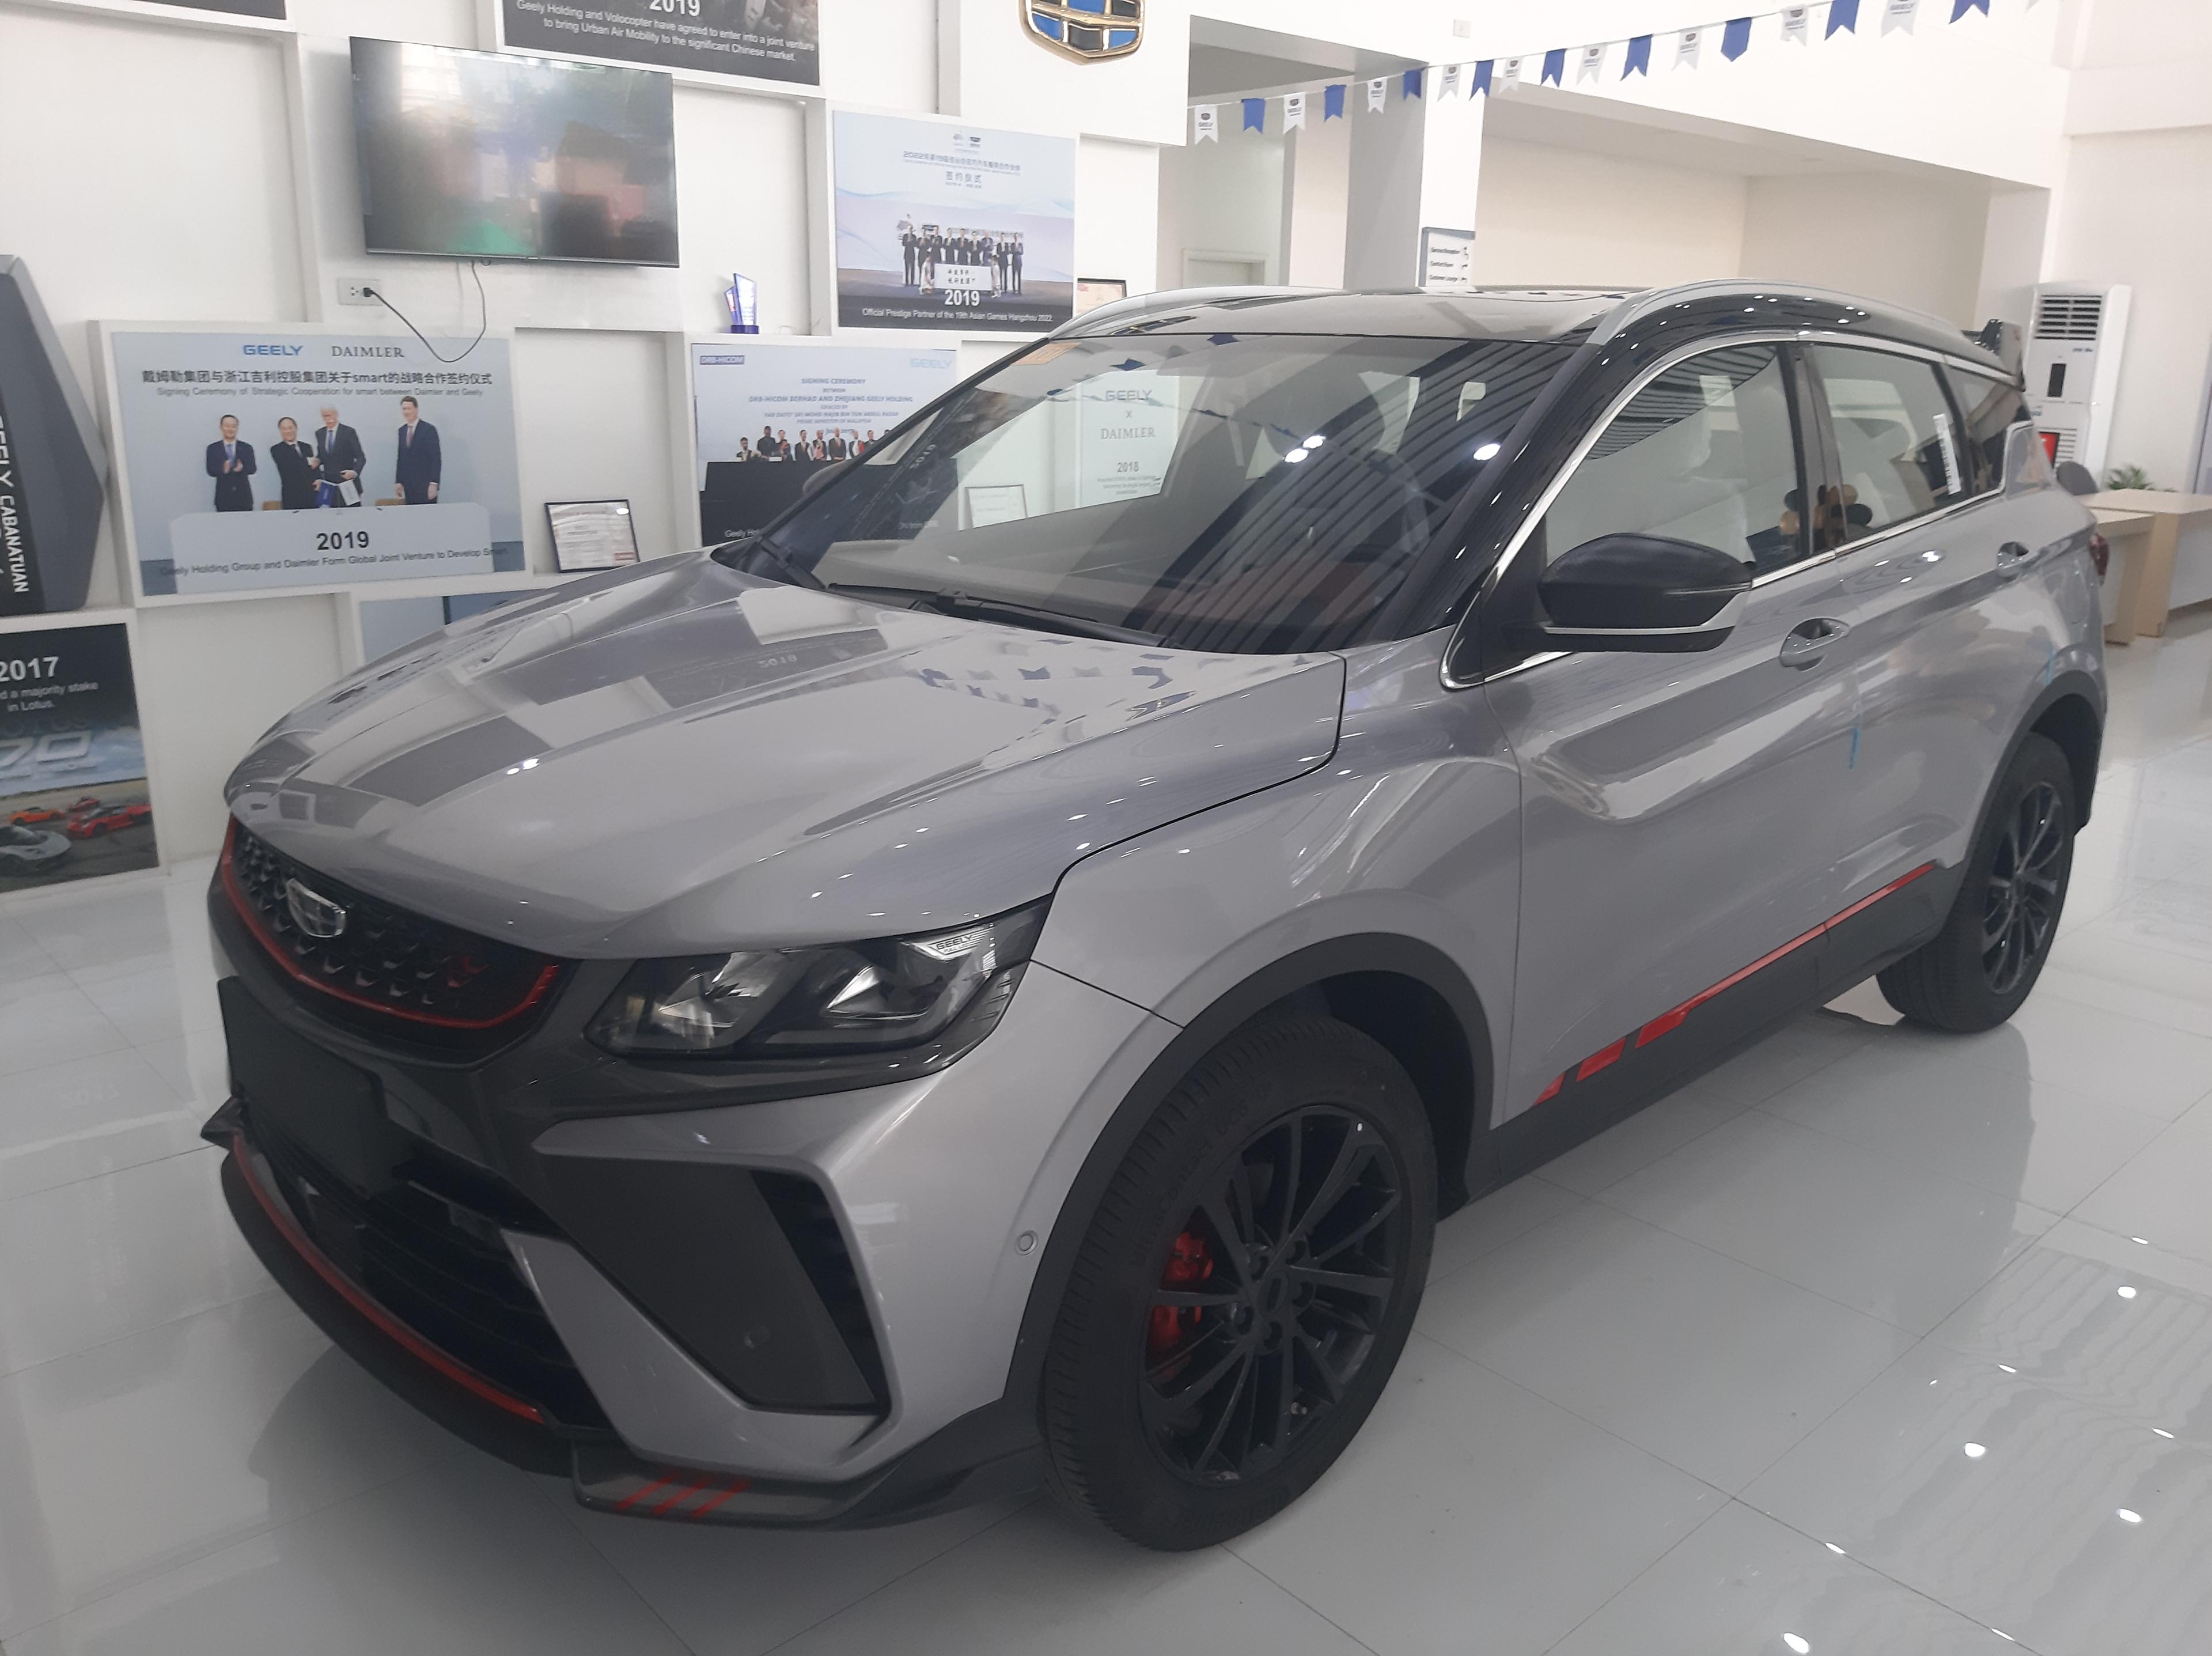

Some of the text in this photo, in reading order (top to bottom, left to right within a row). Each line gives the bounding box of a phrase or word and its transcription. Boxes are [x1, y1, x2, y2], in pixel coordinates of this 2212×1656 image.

[516, 0, 546, 14] Geely
[547, 4, 583, 20] Holding
[585, 10, 603, 20] and
[604, 12, 653, 27] Volocopter
[654, 20, 676, 31] have
[677, 24, 708, 36] agreed
[709, 28, 718, 37] to
[719, 31, 741, 40] enter
[743, 33, 759, 43] into
[767, 35, 784, 47] joint
[785, 39, 815, 51] venture
[544, 18, 796, 61] to bring Urban Air Mobility to the significant Chinese market.
[945, 290, 980, 307] 2019
[862, 308, 885, 316] Official
[886, 309, 912, 319] Prestige
[913, 310, 935, 318] Partner
[243, 345, 404, 357] GEELY DAIMLER
[911, 358, 952, 369] GEELY
[157, 387, 190, 397] Signing
[192, 387, 236, 396] Ceremony
[252, 387, 288, 397] Strategic
[291, 387, 339, 396] Cooperation
[462, 388, 483, 397] Geely
[1105, 390, 1152, 400] GEELY
[1101, 428, 1156, 439] DAIMLER
[1118, 461, 1139, 472] 2018
[316, 531, 369, 550] 2019
[725, 530, 746, 538] Geely
[0, 495, 29, 593] CABANATUAN
[160, 565, 189, 576] Geely
[191, 564, 229, 574] Holding
[231, 562, 261, 572] Group
[263, 560, 282, 569] and
[284, 558, 319, 568] Daimler
[323, 557, 346, 565] Form
[349, 555, 376, 564] Global
[379, 554, 400, 562] Joint
[402, 552, 434, 561] Venture
[437, 551, 446, 559] to
[448, 549, 480, 559] Develop
[0, 656, 59, 682] 2017
[20, 685, 66, 698] majority
[67, 682, 99, 693] stake
[7, 704, 19, 712] in
[936, 935, 972, 950] GEELY
